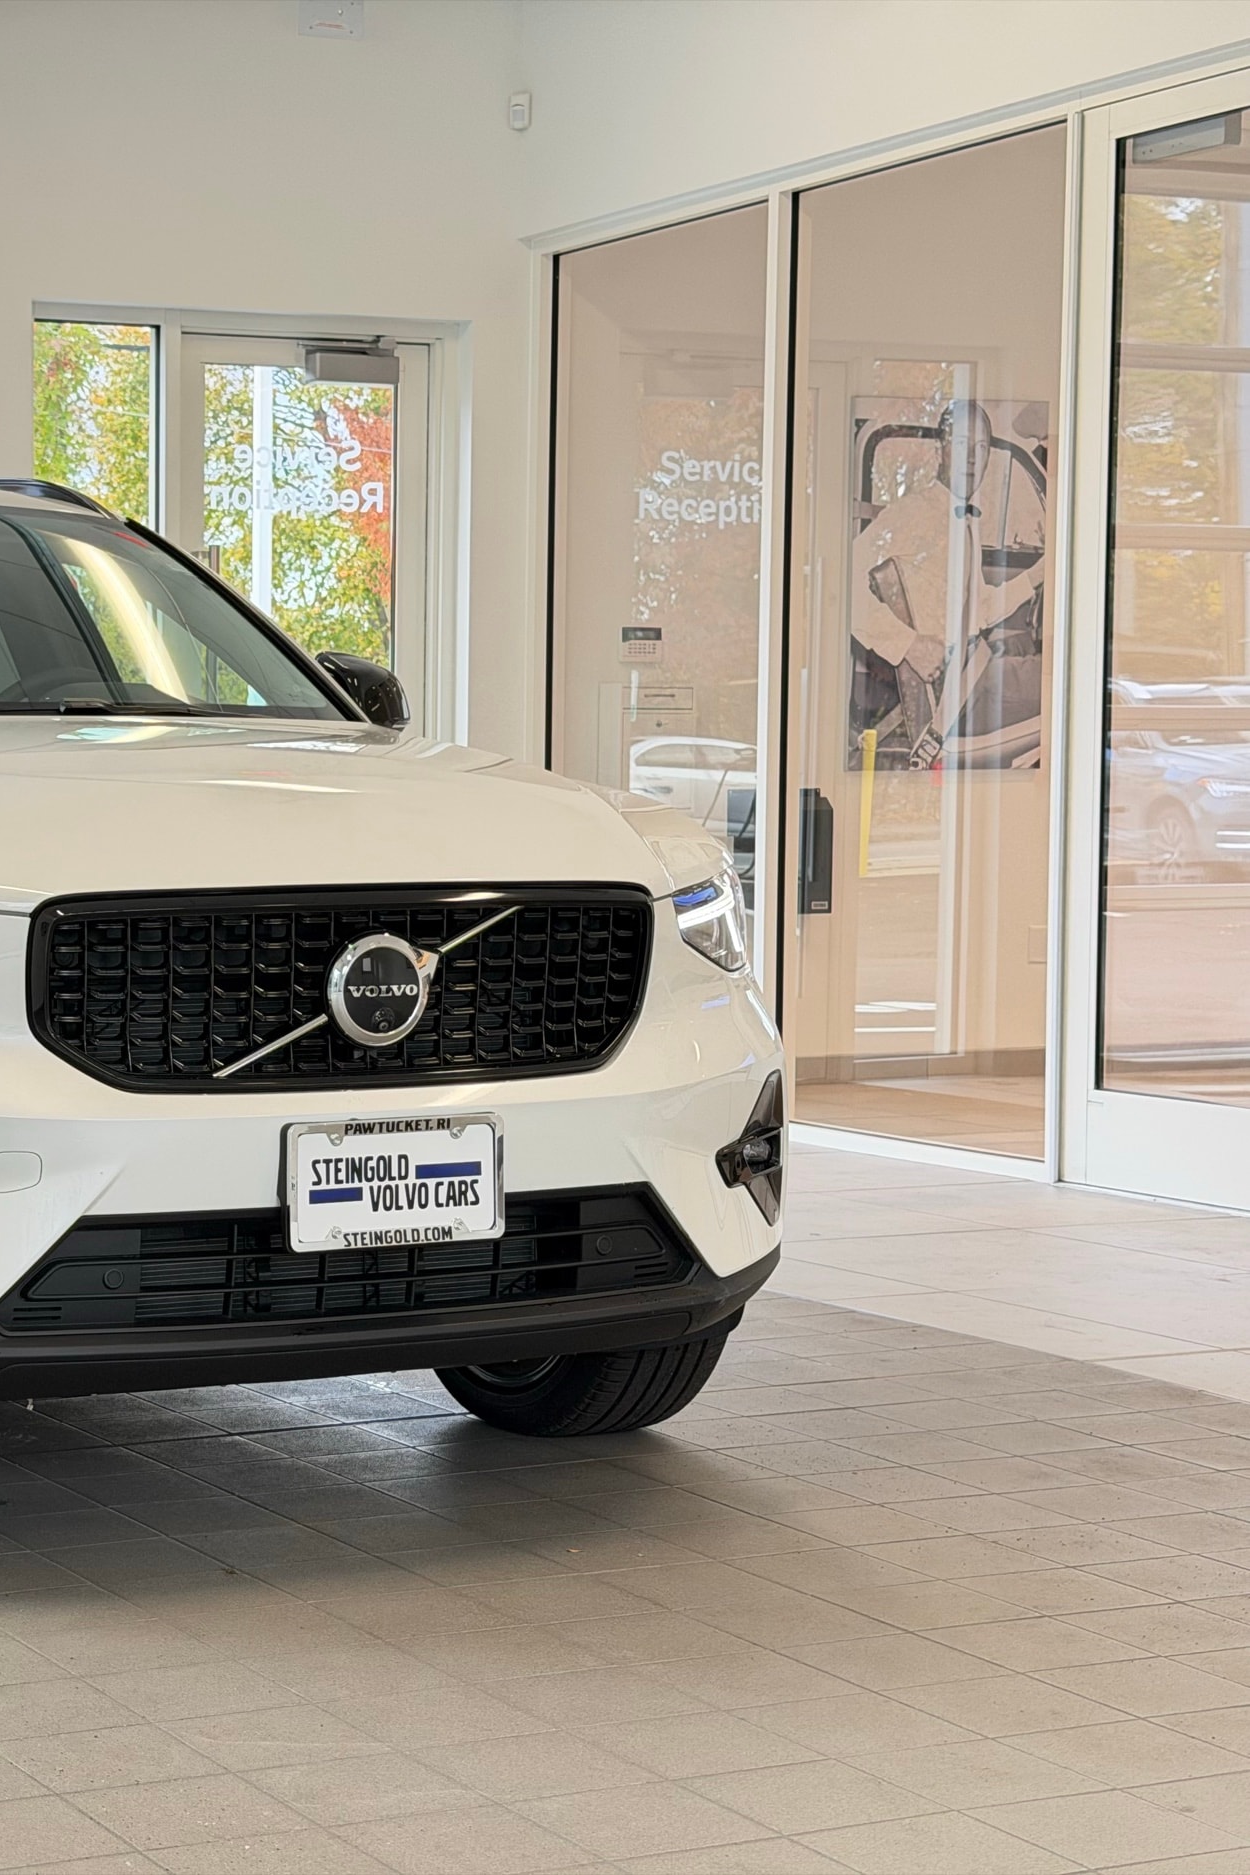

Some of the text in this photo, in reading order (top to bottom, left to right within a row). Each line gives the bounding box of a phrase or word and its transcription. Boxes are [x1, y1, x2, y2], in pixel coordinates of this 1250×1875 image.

[661, 451, 761, 484] Servic
[638, 489, 761, 529] Recepti
[348, 984, 419, 998] VOLVO
[437, 1118, 451, 1130] RI
[311, 1154, 409, 1186] STEINGOLD
[369, 1179, 480, 1212] VOLVO CARS
[344, 1226, 453, 1247] STEINGOLD.COM
